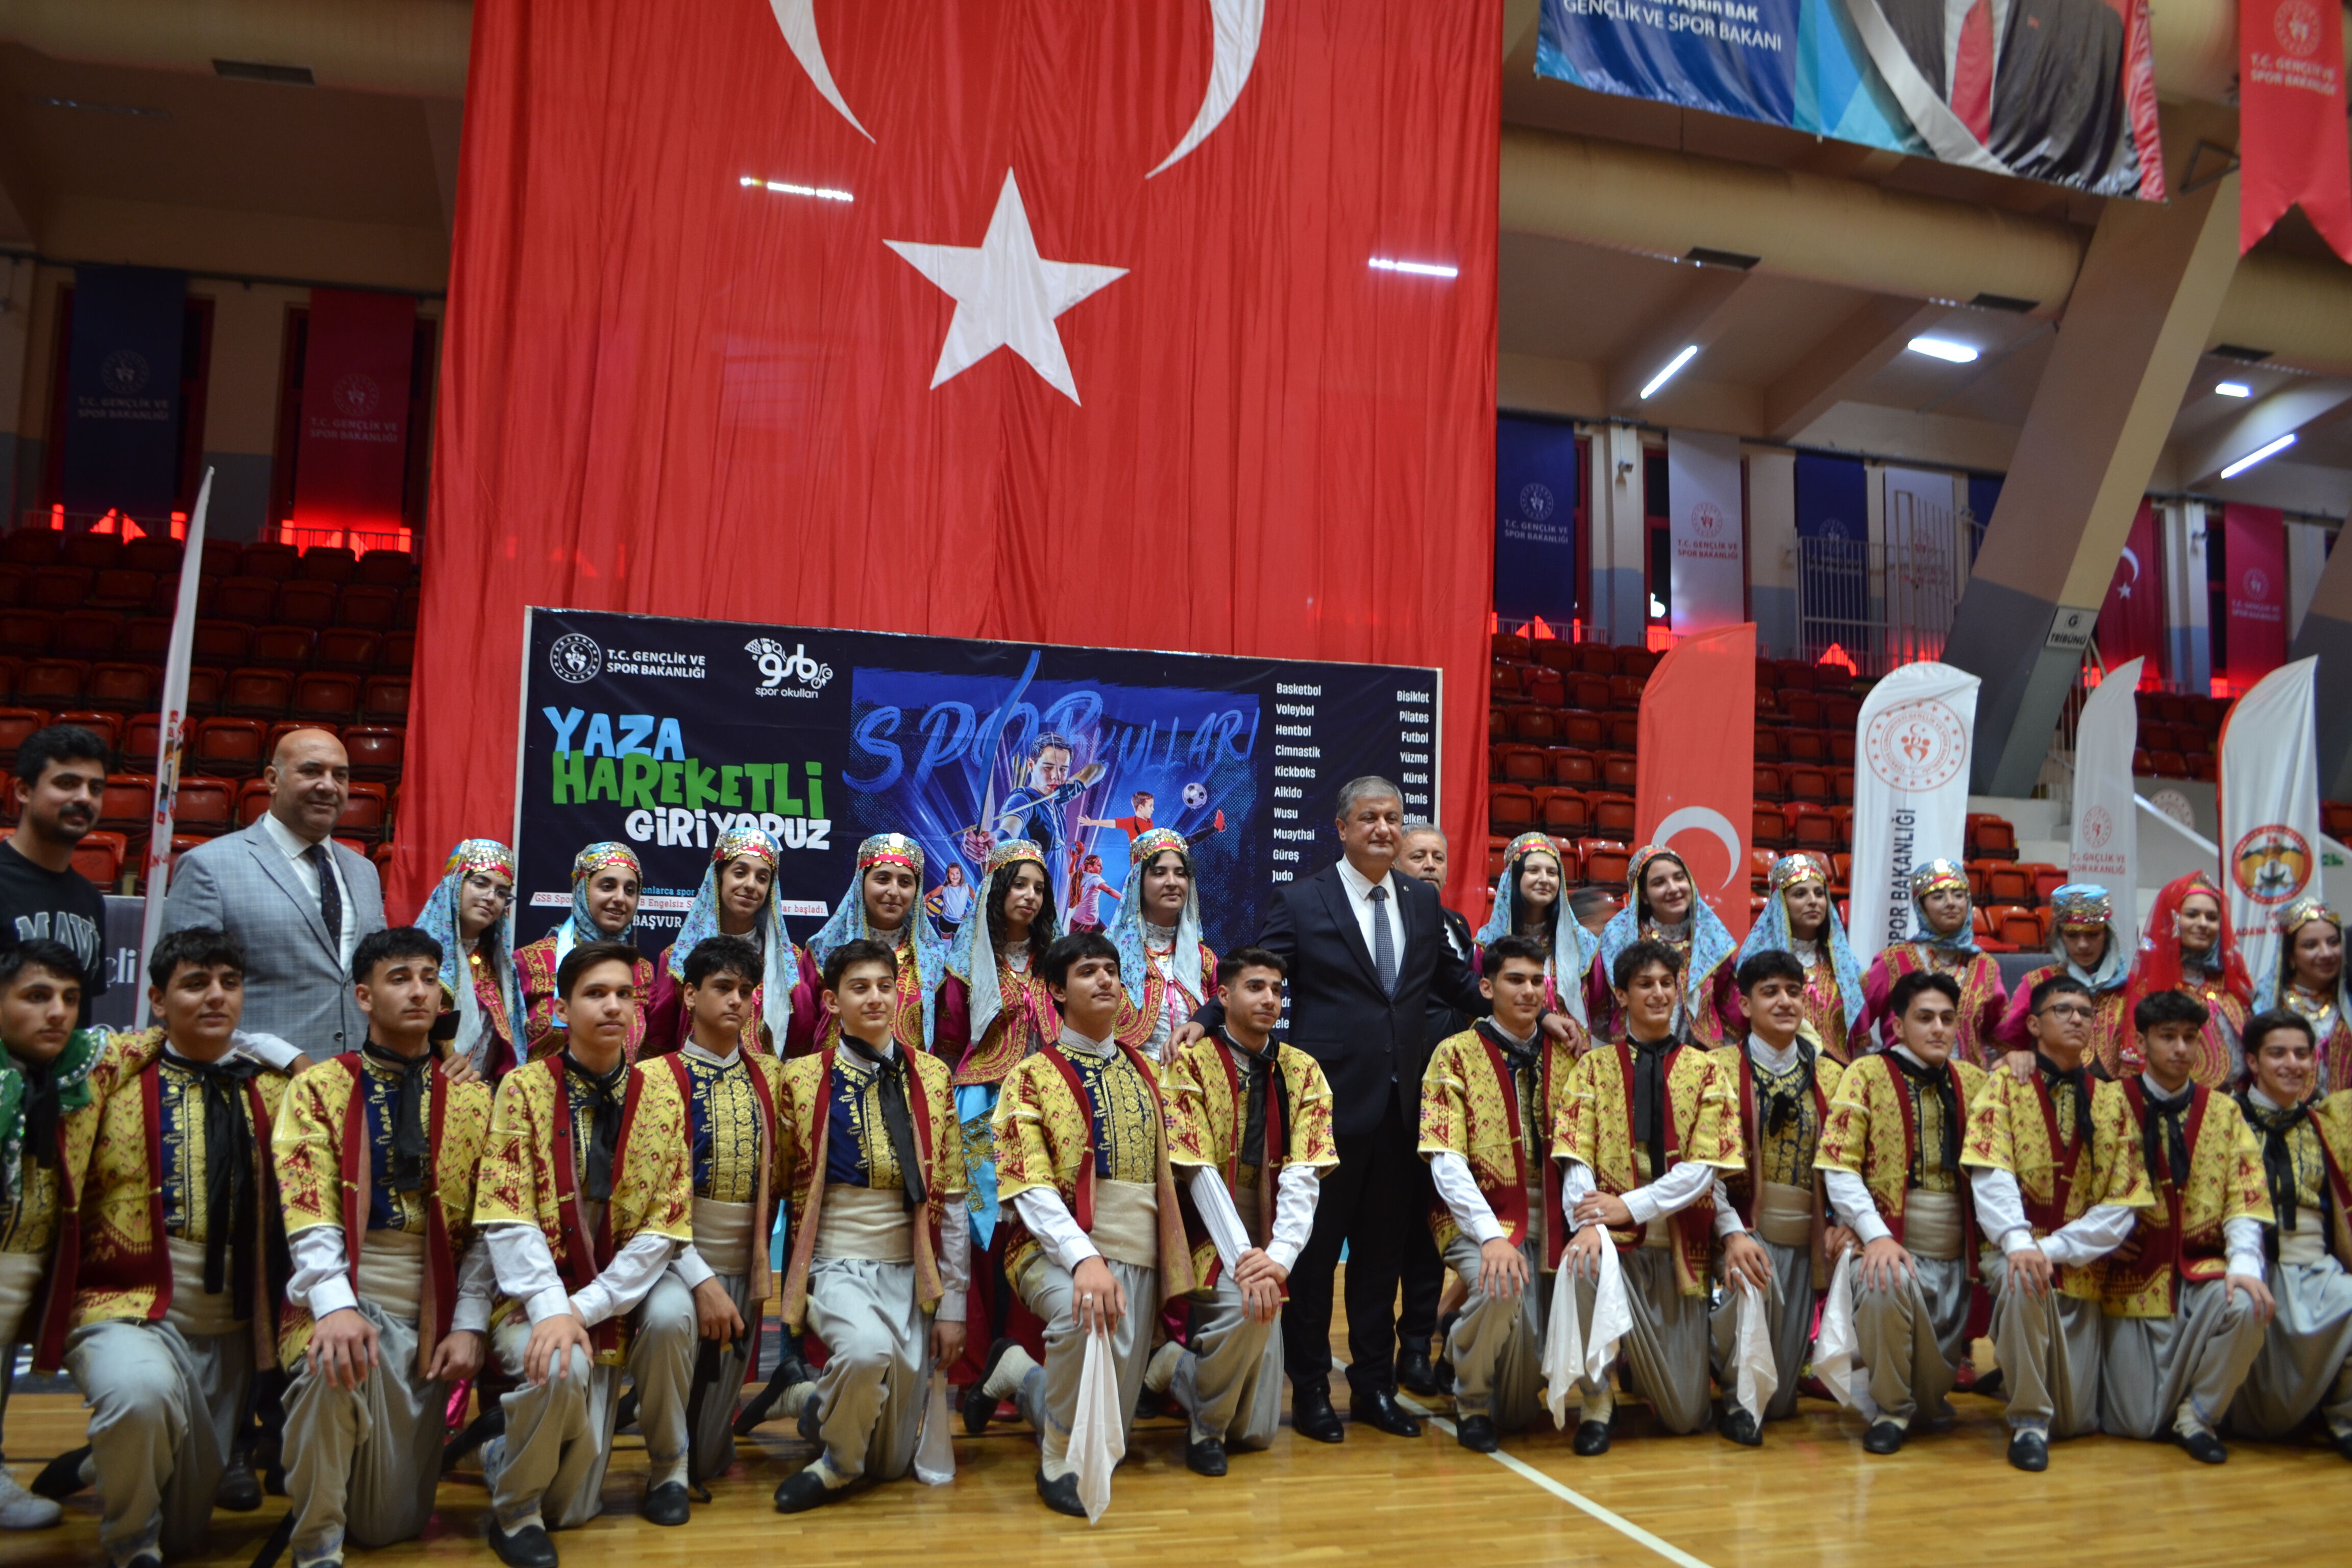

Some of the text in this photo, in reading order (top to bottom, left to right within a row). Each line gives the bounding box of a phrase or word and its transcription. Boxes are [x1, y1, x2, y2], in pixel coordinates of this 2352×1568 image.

[1725, 1, 1758, 23] BAK
[1643, 6, 1664, 29] VE
[1668, 12, 1716, 38] SPOR
[1719, 21, 1781, 51] BAKANI
[607, 649, 706, 666] T.C. GENÇLİK VE
[606, 662, 705, 679] SPOR BAKANLIĞI
[755, 687, 779, 698] spor
[1277, 683, 1321, 696] Basketbol
[1397, 690, 1429, 703] Bisiklet
[1276, 703, 1314, 717] Voleybol
[1400, 710, 1429, 723] Pilates
[543, 706, 685, 761] YAZA
[1276, 724, 1311, 737] Hentbol
[1402, 731, 1428, 743] Futbol
[1276, 744, 1321, 758] Cimnastik
[1400, 751, 1428, 764] Yüzme
[1275, 766, 1315, 778] Kickboks
[1403, 772, 1428, 784] Kürek
[552, 749, 824, 819] HAREKETLİ
[1274, 786, 1302, 798] Aikido
[1405, 793, 1428, 804] Tenis
[1274, 807, 1298, 819] Wusu
[1402, 813, 1427, 824] elken
[1273, 828, 1315, 841] Muaythai
[1273, 849, 1299, 863] Güreş
[1891, 809, 1916, 900] BAKANLIĞI
[1272, 870, 1293, 883] Judo
[535, 894, 551, 902] GSB
[642, 886, 695, 897] onlarca spor
[648, 899, 683, 909] Engelsiz
[795, 905, 825, 914] başladı.
